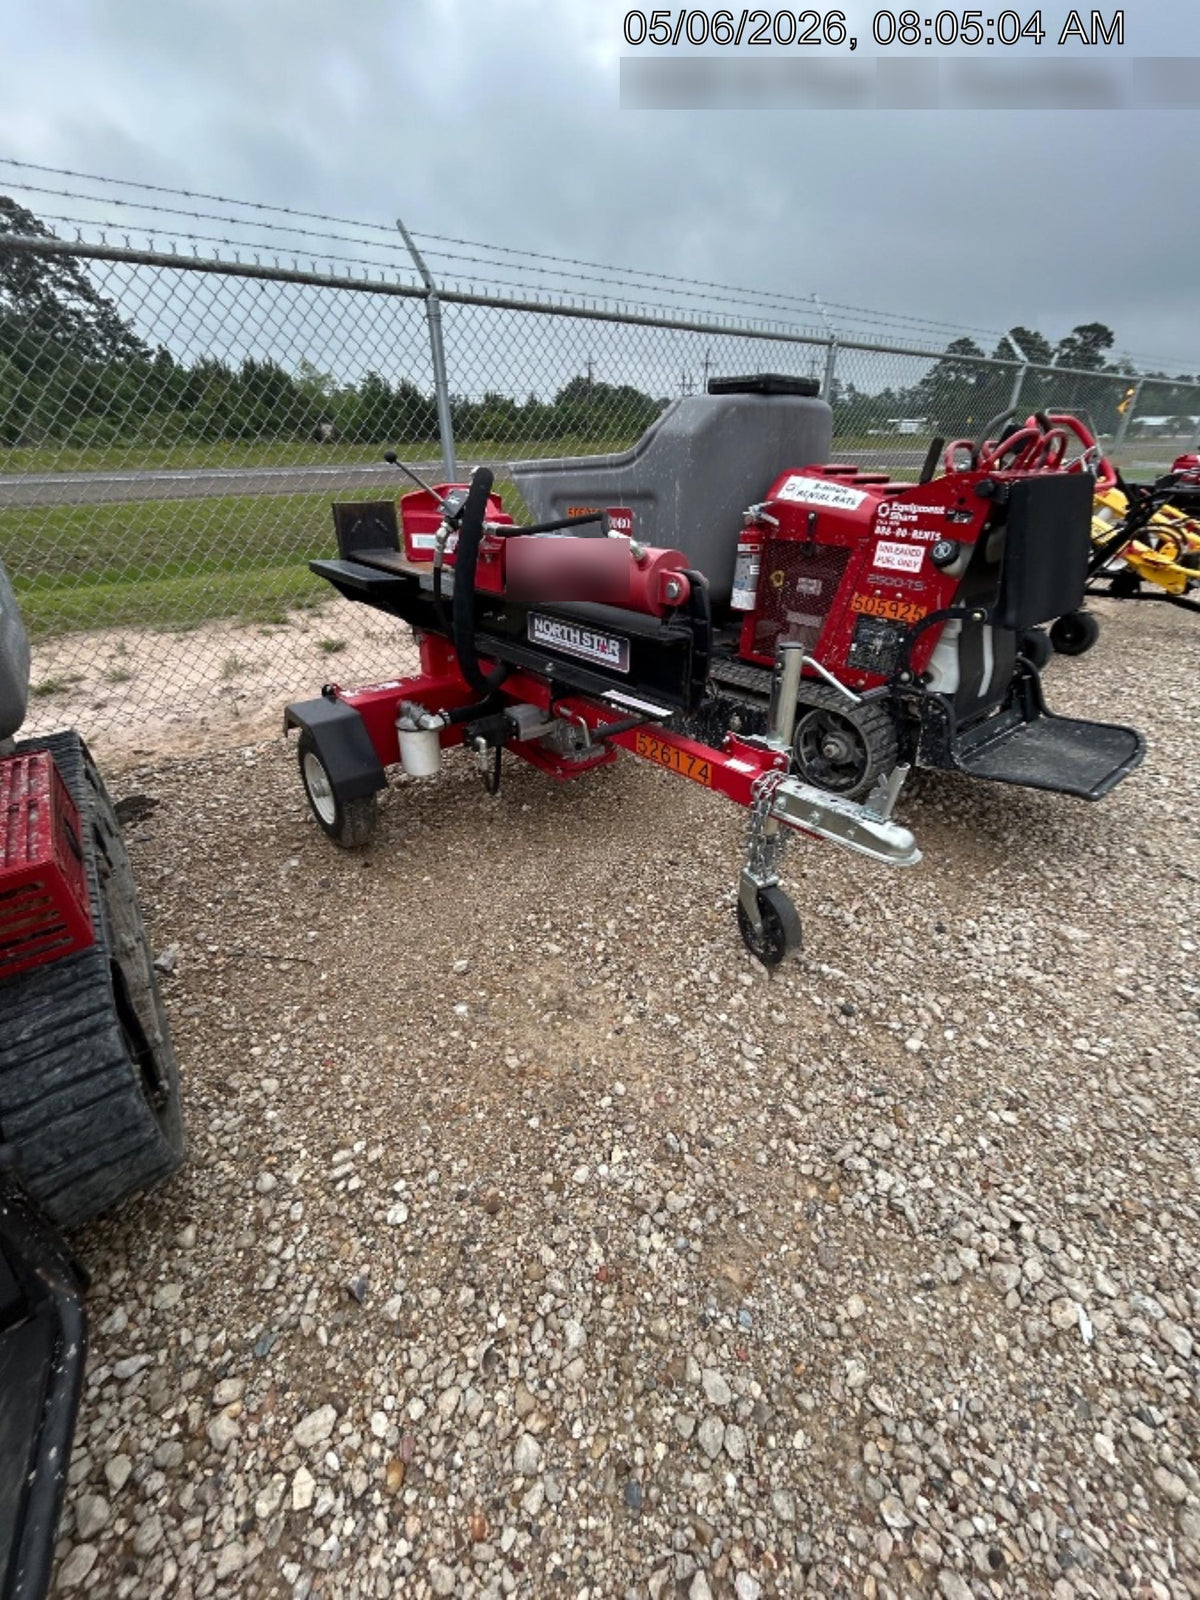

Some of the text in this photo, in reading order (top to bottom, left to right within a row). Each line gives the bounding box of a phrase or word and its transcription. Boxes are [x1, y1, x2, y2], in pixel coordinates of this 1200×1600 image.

[891, 502, 945, 515] Equipment
[889, 511, 918, 522] Share
[874, 526, 942, 541] 888-80-RENTS
[879, 545, 922, 557] UNLEADED
[876, 555, 920, 569] FUEL ONLY
[853, 595, 923, 621] 505925
[637, 734, 711, 783] 526174
